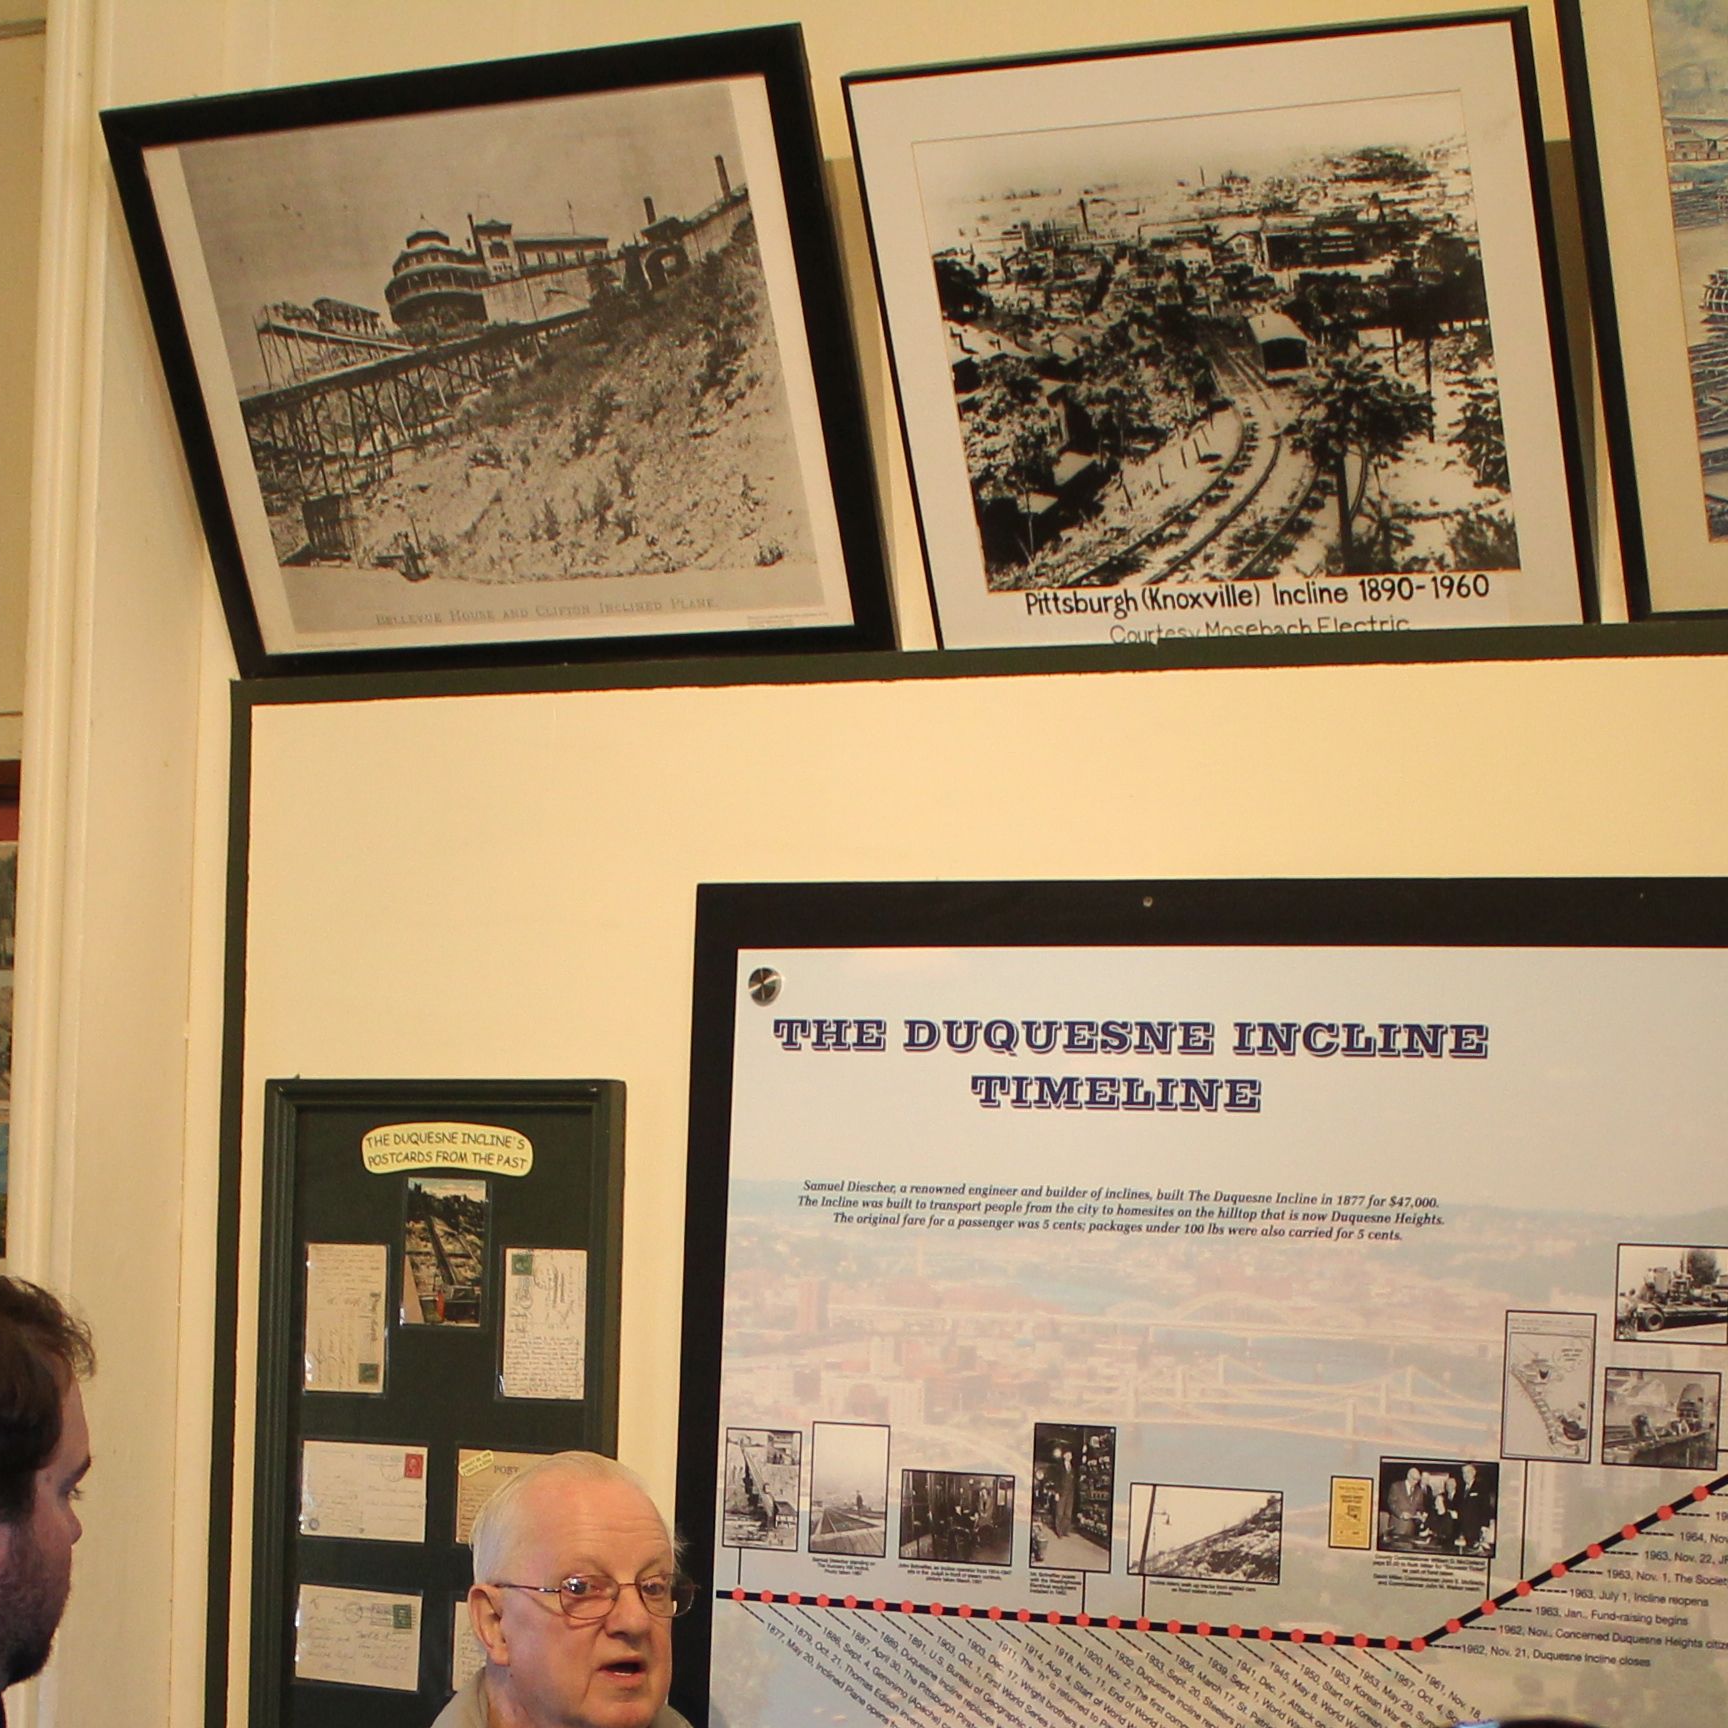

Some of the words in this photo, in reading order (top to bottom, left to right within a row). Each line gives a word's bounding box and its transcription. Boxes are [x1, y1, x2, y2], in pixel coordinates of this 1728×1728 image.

[1025, 589, 1139, 619] Pittsburgh
[1140, 583, 1261, 612] (Knoxville)
[1273, 583, 1349, 606] Incline
[1359, 574, 1490, 601] 1890-1960
[773, 1018, 887, 1052] THE
[902, 1018, 1216, 1058] DUQUESNE
[1231, 1021, 1490, 1059] INCLINE
[971, 1074, 1263, 1112] TIMELINE
[365, 1133, 390, 1149] THE
[393, 1131, 459, 1145] DUQUESNE
[461, 1132, 525, 1150] INCLINE'S
[368, 1151, 433, 1167] POSTCARDS
[435, 1150, 468, 1164] FROM
[472, 1152, 494, 1165] THE
[496, 1153, 528, 1169] PAST
[803, 1180, 844, 1191] Samuel
[847, 1181, 896, 1194] Diescher,
[899, 1185, 907, 1193] a
[909, 1183, 966, 1194] renowned
[968, 1185, 1018, 1198] engineer
[1020, 1185, 1043, 1197] and
[1045, 1185, 1088, 1197] builder
[1090, 1187, 1103, 1201] of
[1104, 1187, 1152, 1201] inclines,
[1156, 1188, 1184, 1200] built
[1188, 1189, 1210, 1201] The
[1213, 1190, 1272, 1205] Duquesne
[1275, 1192, 1317, 1204] Incline
[1320, 1193, 1332, 1205] in
[1337, 1195, 1365, 1205] 1877
[1366, 1194, 1386, 1209] for
[1389, 1195, 1439, 1208] $47,000.
[798, 1195, 818, 1206] The
[821, 1195, 858, 1207] Incline
[862, 1200, 883, 1208] was
[886, 1197, 912, 1209] built
[915, 1199, 926, 1209] to
[929, 1200, 981, 1214] transport
[983, 1200, 1022, 1215] people
[1024, 1201, 1052, 1215] from
[1055, 1202, 1074, 1213] the
[1077, 1203, 1098, 1217] city
[1102, 1205, 1113, 1215] to
[1116, 1203, 1174, 1216] homesites
[1177, 1209, 1191, 1217] on
[1195, 1206, 1214, 1218] the
[1217, 1206, 1257, 1222] hilltop
[1260, 1208, 1285, 1220] that
[1289, 1209, 1299, 1220] is
[1301, 1213, 1327, 1221] now
[1331, 1210, 1391, 1225] Duquesne
[1394, 1212, 1444, 1227] Heights.
[833, 1211, 853, 1223] The
[856, 1213, 900, 1226] original
[901, 1213, 925, 1227] fare
[927, 1214, 945, 1228] for
[957, 1219, 1014, 1230] passenger
[1018, 1221, 1039, 1229] was
[1042, 1219, 1049, 1229] 5
[1052, 1220, 1085, 1231] cents;
[1087, 1220, 1142, 1234] packages
[1146, 1221, 1180, 1233] under
[1184, 1223, 1204, 1234] 100
[1207, 1222, 1224, 1235] lbs
[1228, 1227, 1257, 1236] were
[1260, 1224, 1285, 1236] also
[1288, 1226, 1333, 1238] carried
[1334, 1227, 1354, 1241] for
[1357, 1228, 1364, 1239] 5
[1367, 1230, 1402, 1240] cents.
